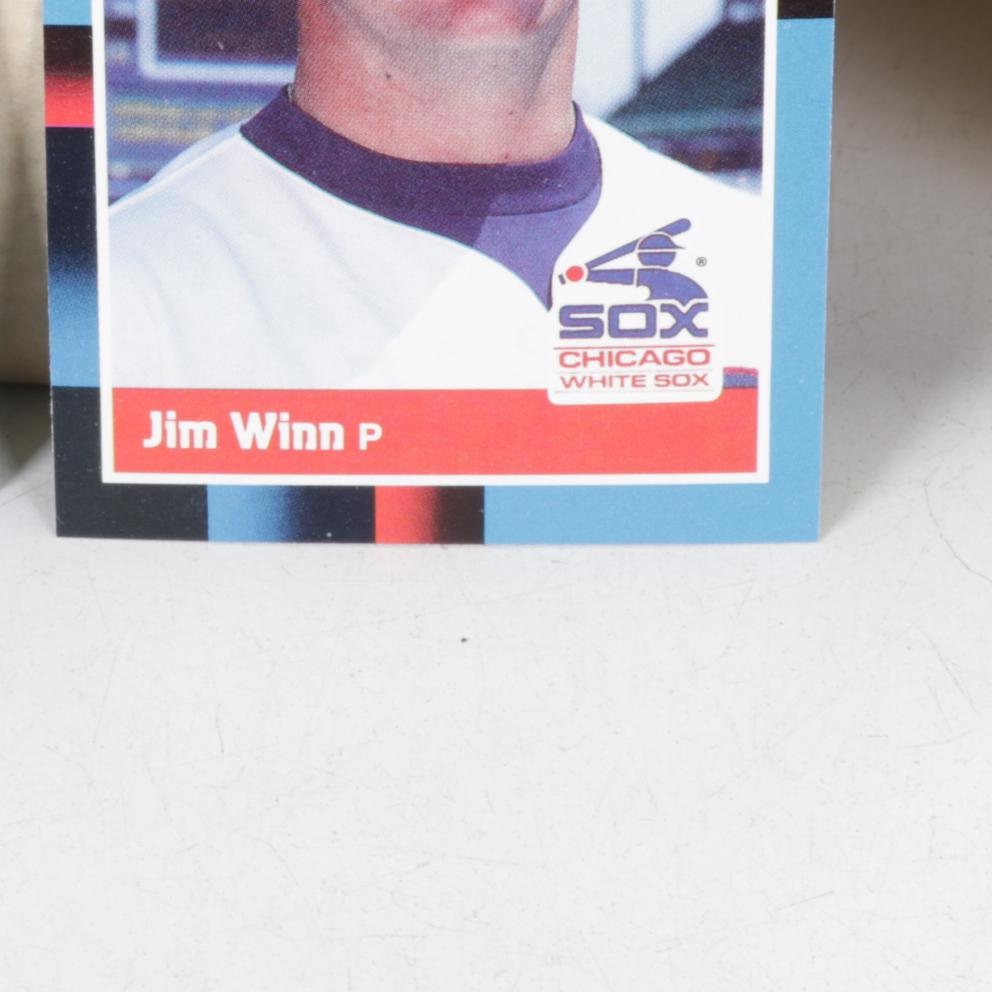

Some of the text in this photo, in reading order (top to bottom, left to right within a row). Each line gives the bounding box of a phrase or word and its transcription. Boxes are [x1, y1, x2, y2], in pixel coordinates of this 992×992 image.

[558, 302, 709, 340] SOX
[558, 349, 711, 369] CHICAGO
[560, 373, 710, 389] WHITE SOX
[142, 409, 384, 451] Jim Winn P
